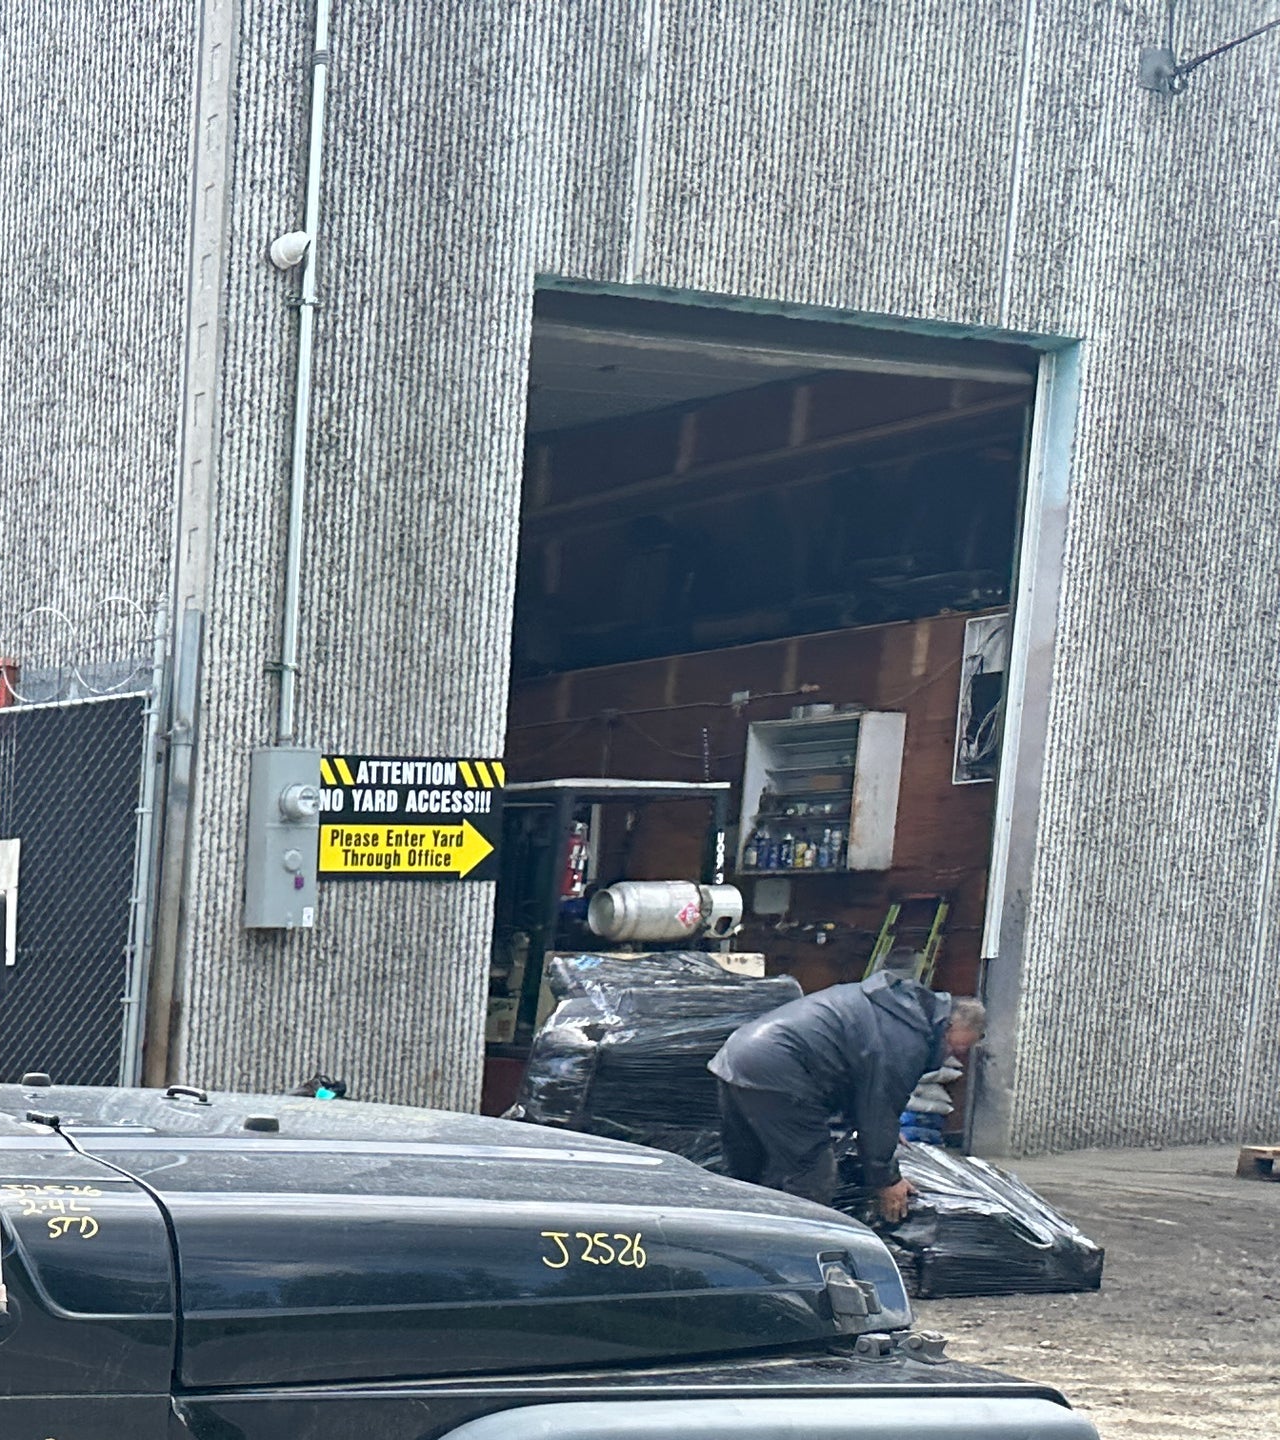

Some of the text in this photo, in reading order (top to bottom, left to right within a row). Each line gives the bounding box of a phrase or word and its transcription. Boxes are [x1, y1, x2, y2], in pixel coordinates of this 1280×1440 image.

[356, 761, 457, 786] ATTENTION
[319, 788, 491, 814] NO YARD ACCESS!!!
[330, 829, 464, 847] Please Enter Yard
[342, 849, 452, 870] Through Office
[46, 1215, 99, 1239] STD
[541, 1230, 647, 1270] J2526
